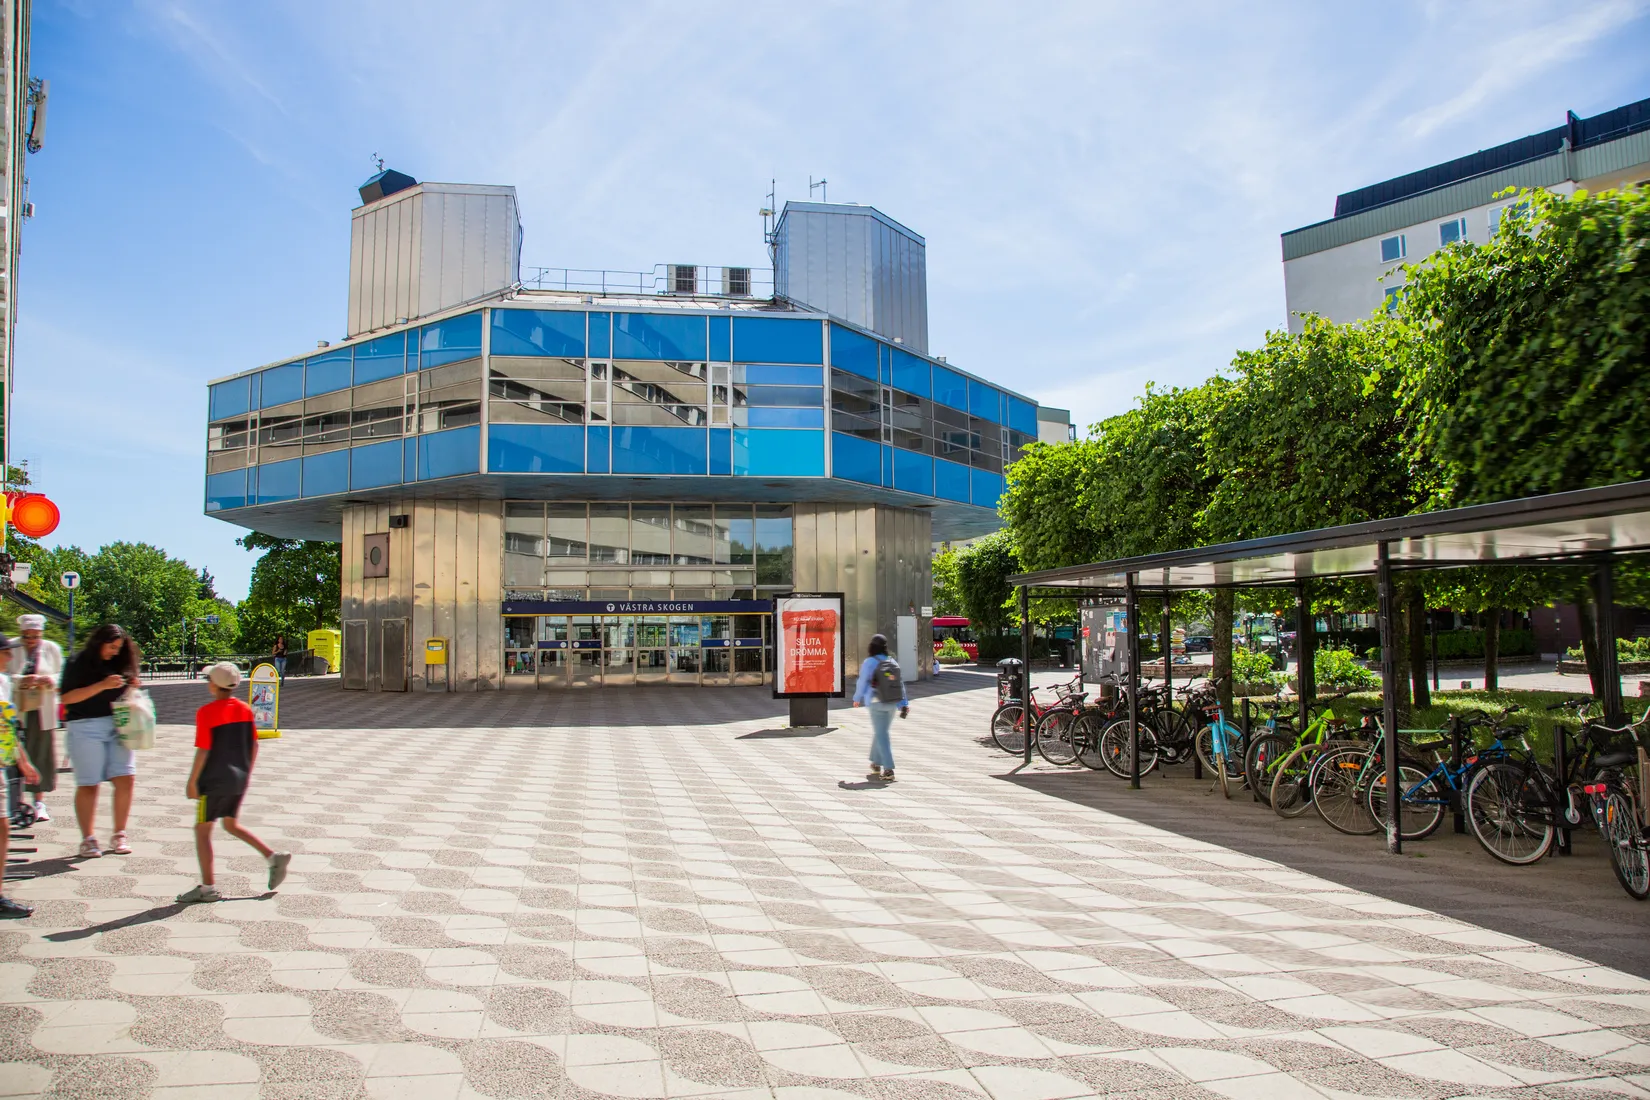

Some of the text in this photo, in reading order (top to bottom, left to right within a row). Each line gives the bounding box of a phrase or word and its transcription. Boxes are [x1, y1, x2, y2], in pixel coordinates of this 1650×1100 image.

[64, 574, 77, 587] T
[619, 602, 654, 611] VÄSTRA
[657, 603, 694, 611] SKOGEN
[796, 637, 822, 646] SLUTA
